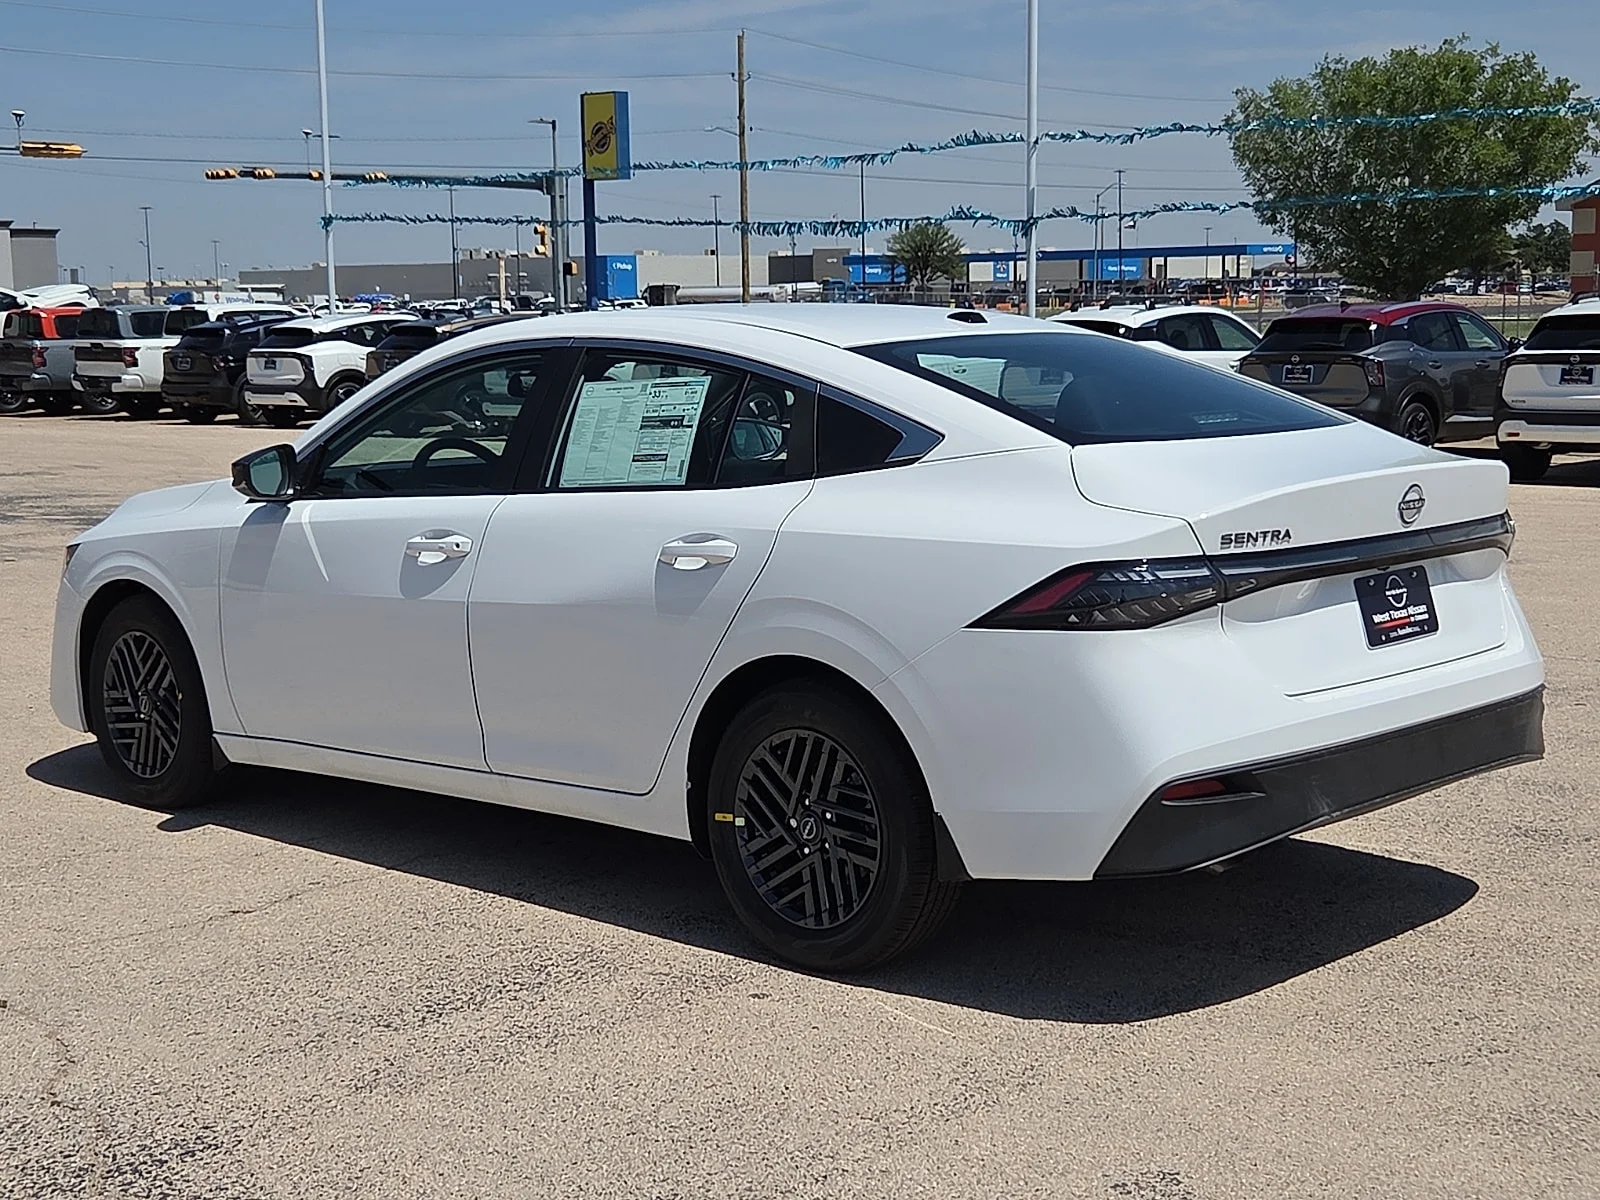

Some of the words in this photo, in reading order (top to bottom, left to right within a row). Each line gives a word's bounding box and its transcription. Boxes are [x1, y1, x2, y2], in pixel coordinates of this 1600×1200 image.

[1220, 528, 1292, 546] SENTRA
[1372, 612, 1391, 623] West
[1389, 608, 1409, 619] Texas
[1407, 604, 1428, 615] Nissan
